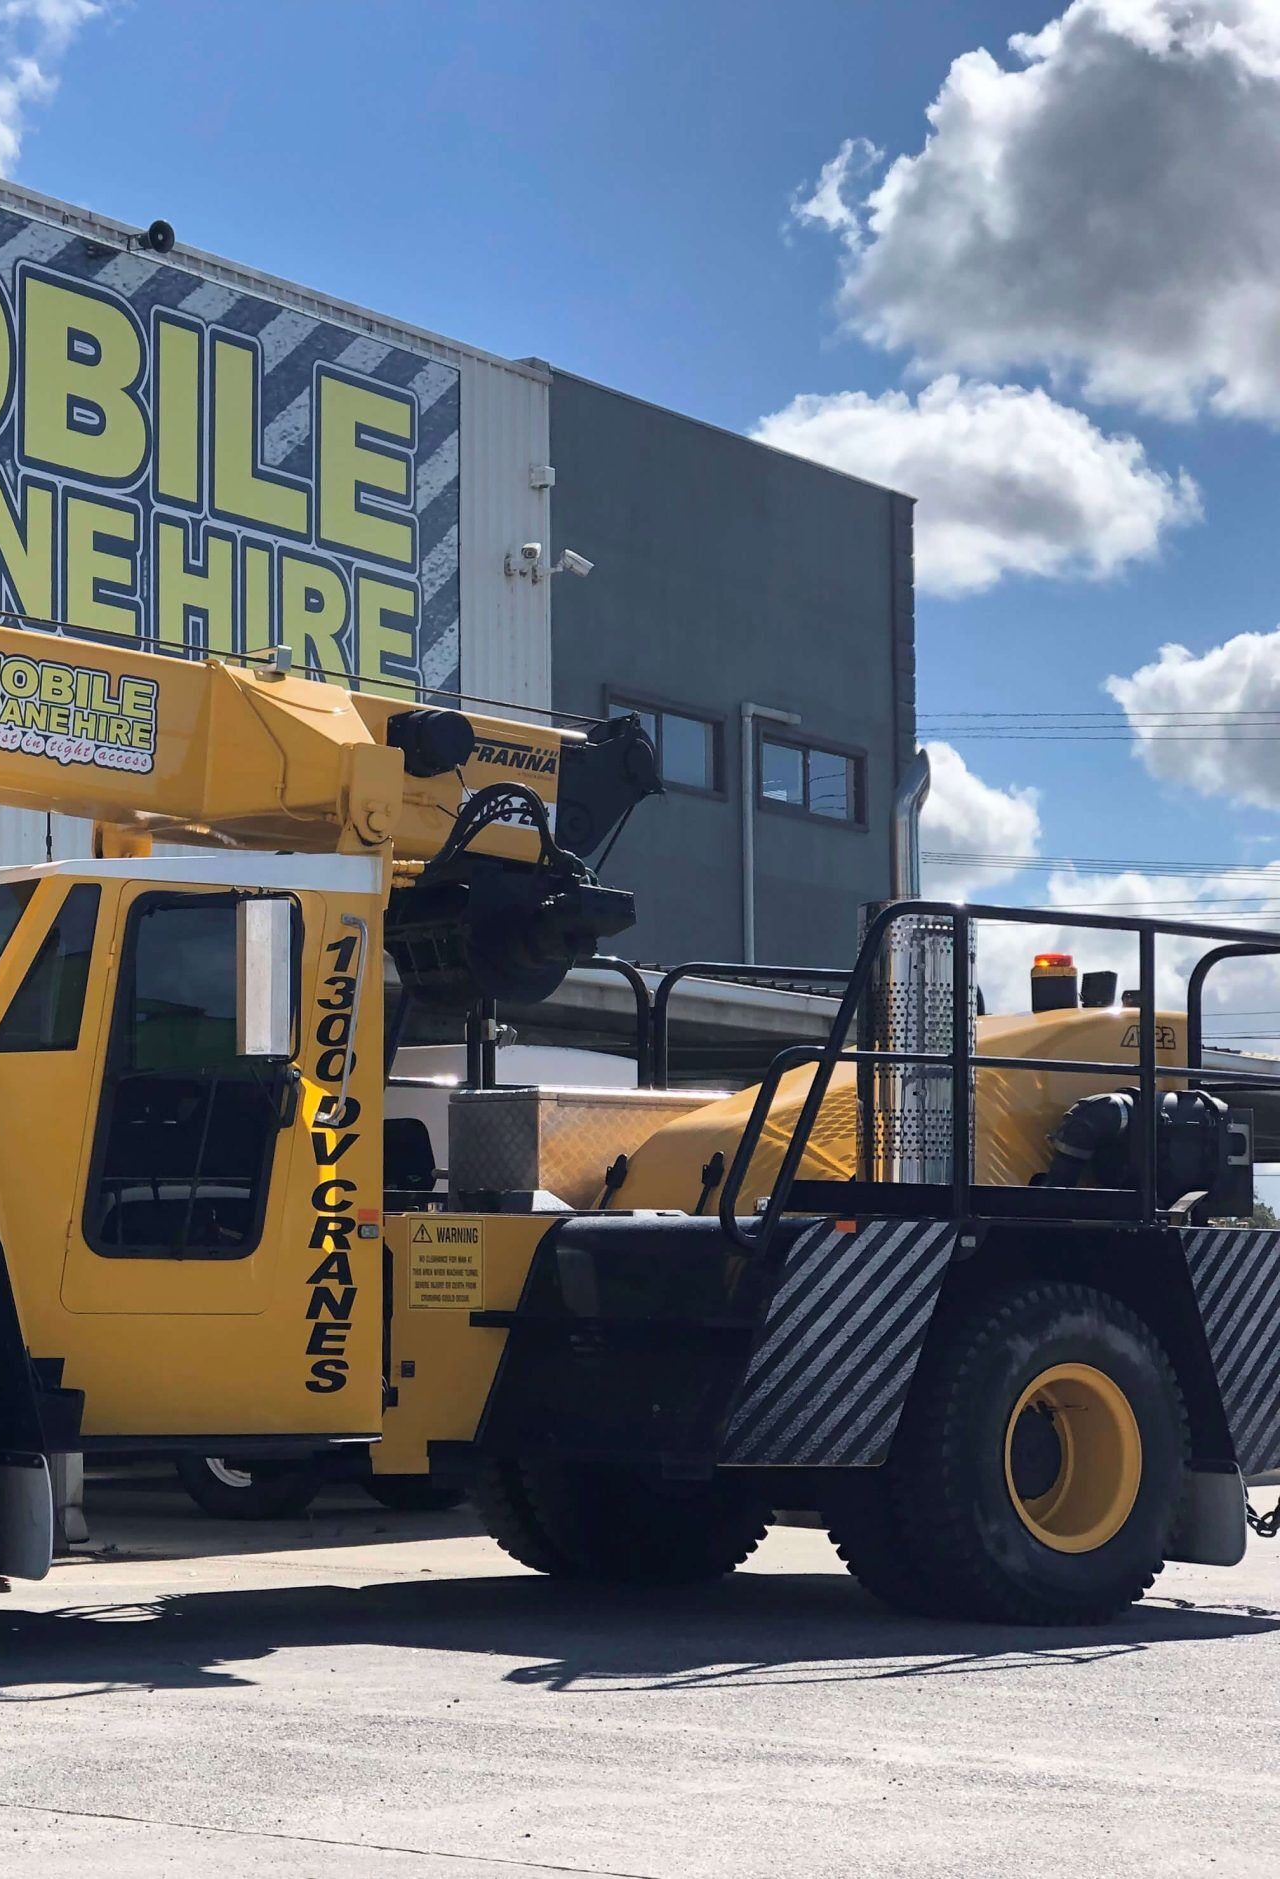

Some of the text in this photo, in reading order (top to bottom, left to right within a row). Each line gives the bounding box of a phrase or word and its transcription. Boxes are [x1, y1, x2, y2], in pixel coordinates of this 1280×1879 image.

[159, 521, 417, 704] HIRE
[73, 711, 153, 750] HIRE
[25, 733, 43, 750] in
[49, 738, 91, 762] tight
[97, 750, 150, 768] access
[473, 745, 557, 774] RANNA
[1120, 1024, 1176, 1050] A22
[305, 935, 361, 1394] 1300 DV CRANES
[436, 1227, 478, 1244] WARNING
